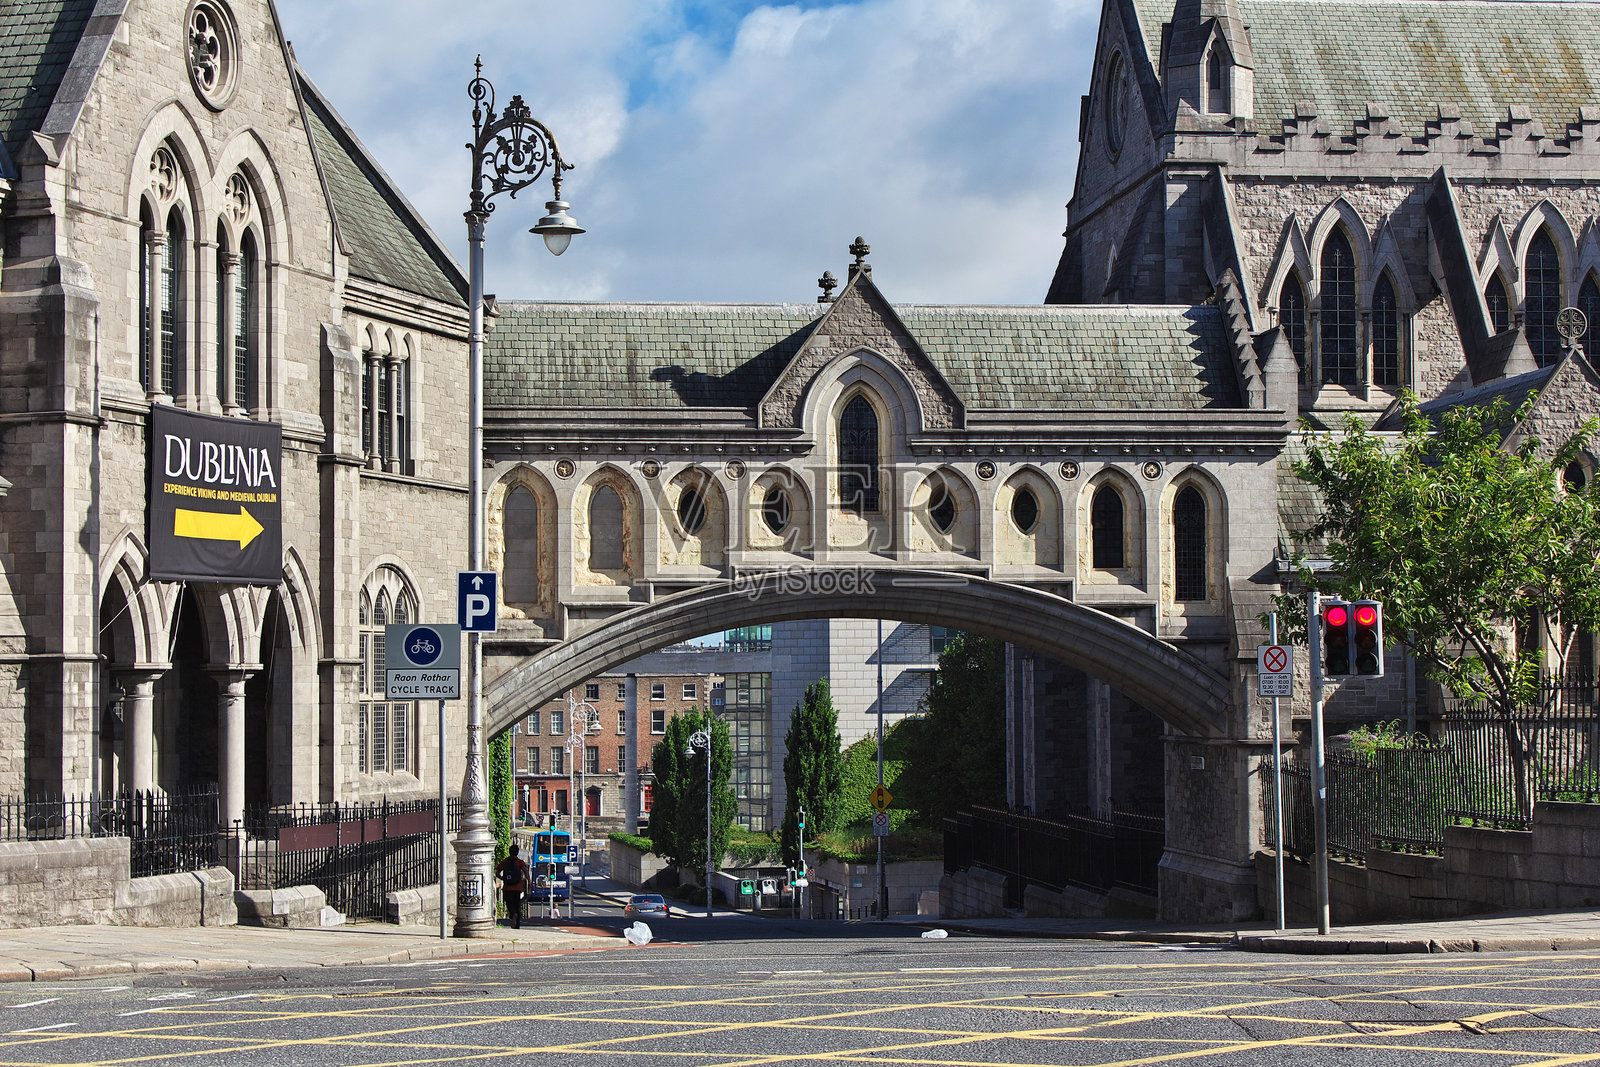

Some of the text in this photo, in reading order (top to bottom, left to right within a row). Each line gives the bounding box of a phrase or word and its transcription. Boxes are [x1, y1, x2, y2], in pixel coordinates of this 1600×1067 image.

[164, 434, 277, 488] DUBLINIA
[164, 483, 277, 503] EXPERIENCE VIKING AND MEDIEVAL DUBLIN
[466, 594, 490, 628] P
[394, 674, 451, 682] Raon Rothar
[390, 686, 454, 694] CYCLE TRACK
[569, 852, 576, 861] P
